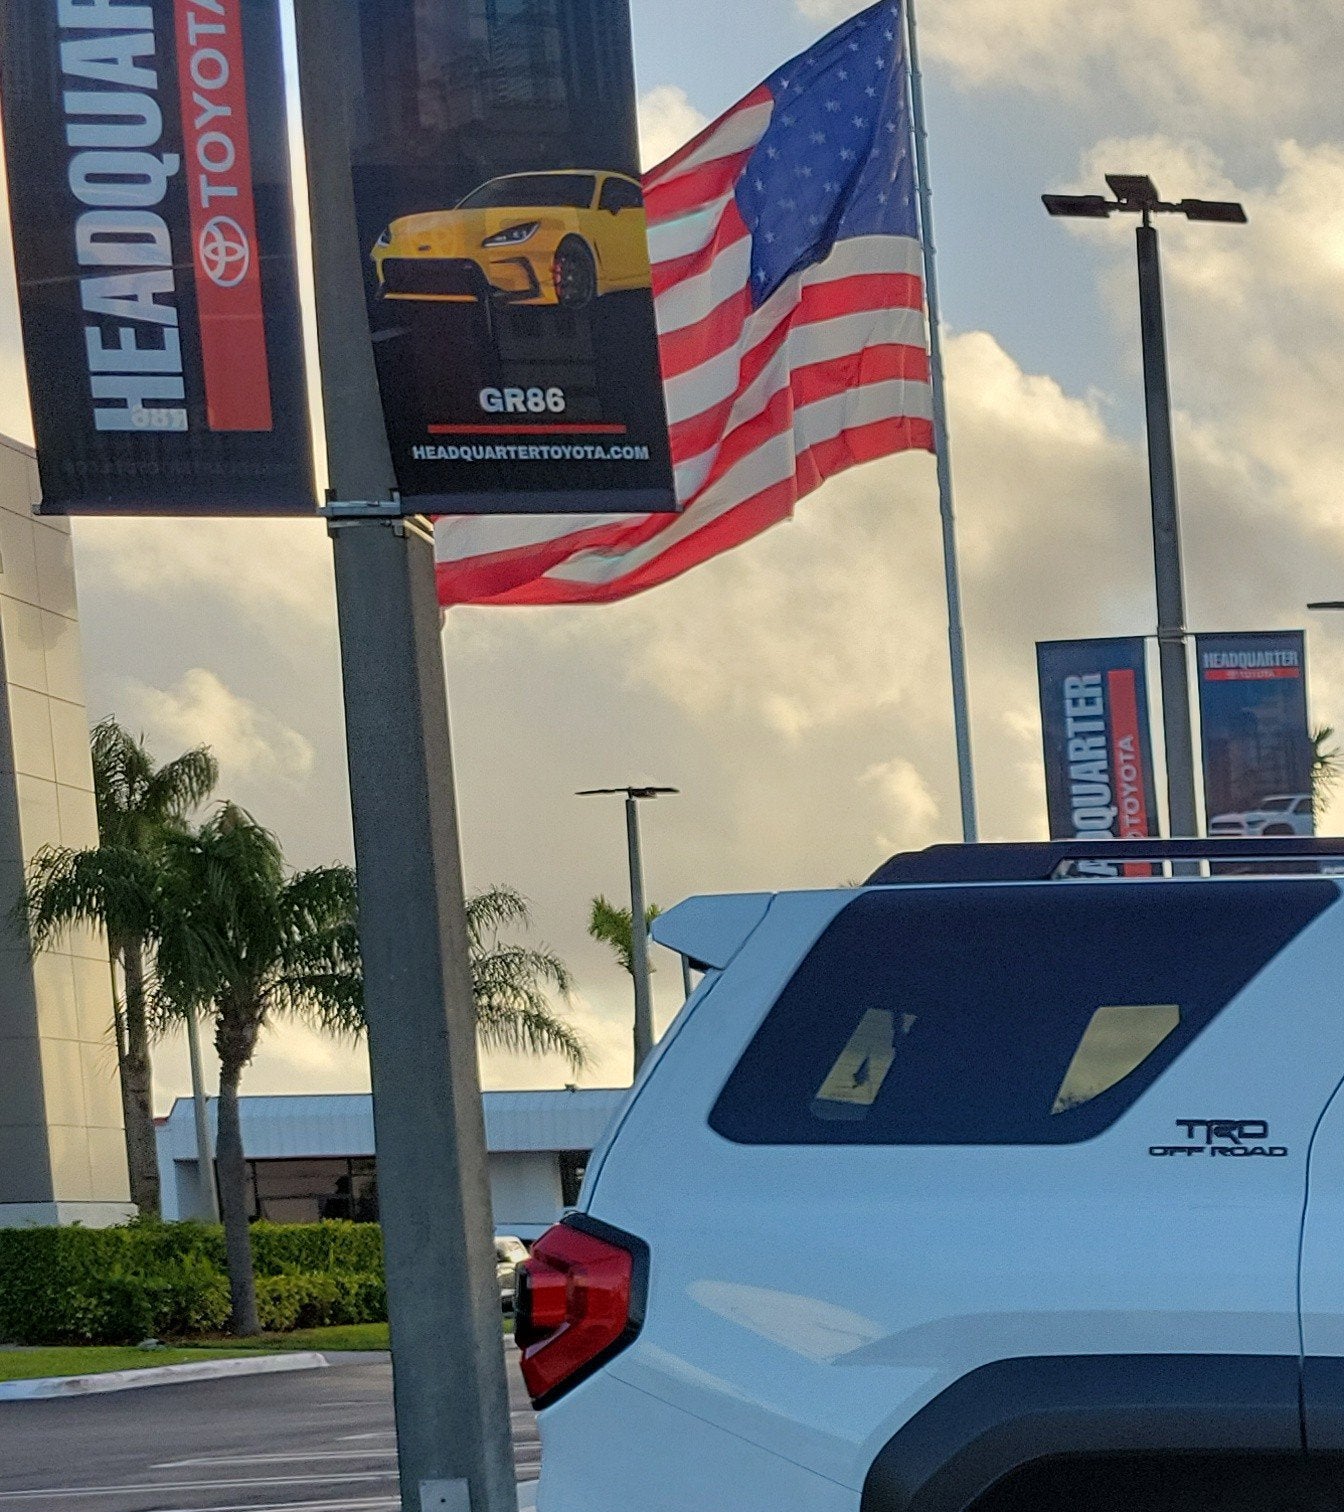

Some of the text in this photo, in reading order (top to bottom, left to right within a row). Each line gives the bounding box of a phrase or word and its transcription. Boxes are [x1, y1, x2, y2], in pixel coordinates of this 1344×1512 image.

[478, 387, 567, 413] GR86
[412, 445, 650, 462] HEADQUARTERTOYOTA.COM
[1203, 650, 1299, 669] HEADQUARTER
[1118, 734, 1142, 829] TOYOTA
[1175, 1118, 1269, 1145] TRD
[1148, 1146, 1288, 1157] OFF ROAD
